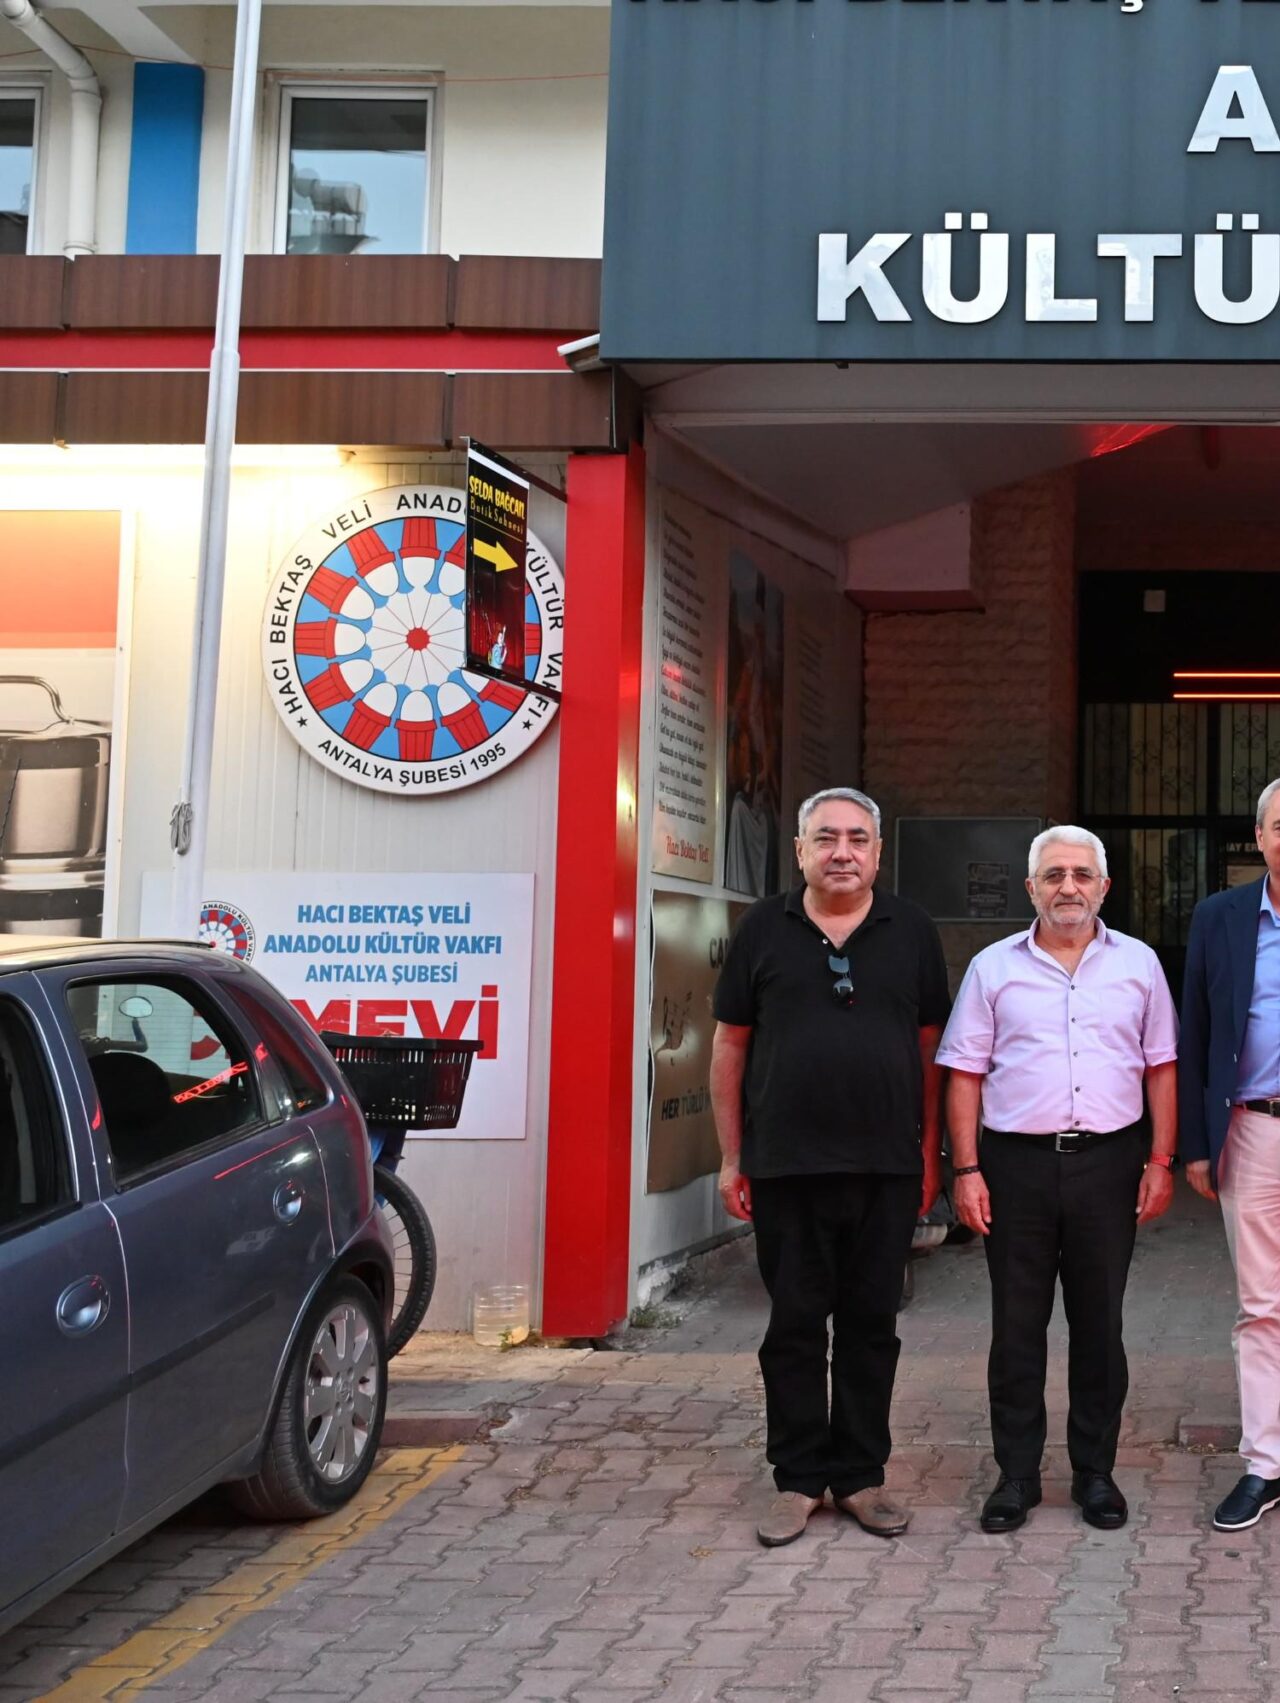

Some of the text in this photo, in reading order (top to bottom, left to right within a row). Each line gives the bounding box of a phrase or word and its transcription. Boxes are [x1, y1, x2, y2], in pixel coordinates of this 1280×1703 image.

[396, 492, 467, 514] ANAD
[469, 475, 526, 520] SELDA BAĞCAN
[321, 499, 373, 539] VELİ
[269, 554, 314, 644] BEKTAŞ
[271, 658, 303, 714] HACI
[317, 739, 507, 787] ANTALYA ŞUBESİ 1995
[297, 902, 471, 926] HACI BEKTAŞ VELİ
[263, 931, 502, 954] ANADOLU KÜLTÜR VAKFI
[305, 961, 458, 985] ANTALYA ŞUBESİ
